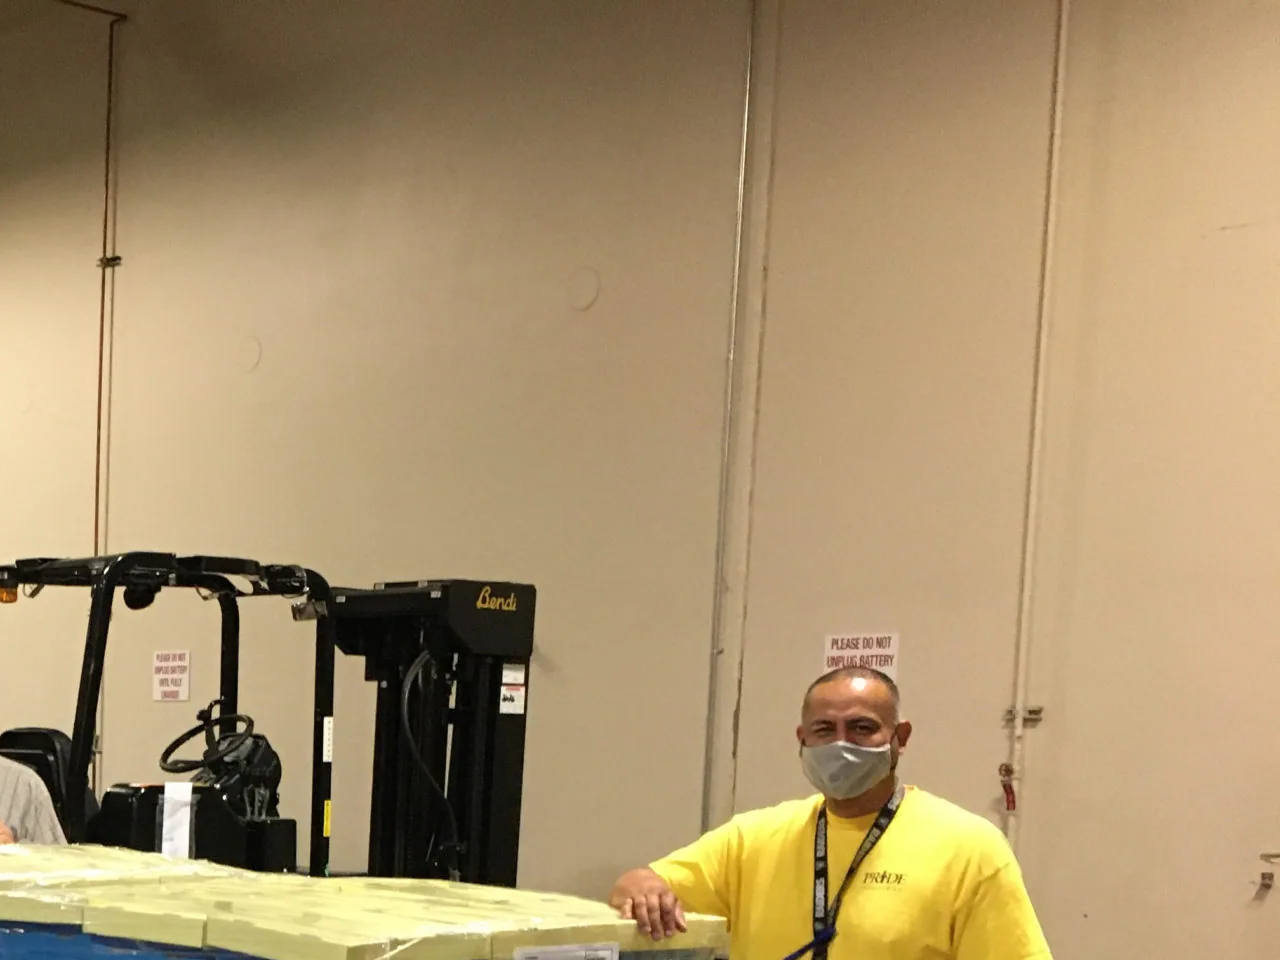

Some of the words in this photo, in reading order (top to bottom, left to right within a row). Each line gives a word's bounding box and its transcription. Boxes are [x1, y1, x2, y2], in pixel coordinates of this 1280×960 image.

[476, 585, 517, 611] Bendi
[831, 636, 860, 650] PLEASE
[862, 636, 874, 650] DO
[876, 635, 892, 649] NOT
[826, 655, 858, 668] UNPLUG
[859, 654, 895, 667] BATTERY
[863, 870, 906, 885] PRIDE
